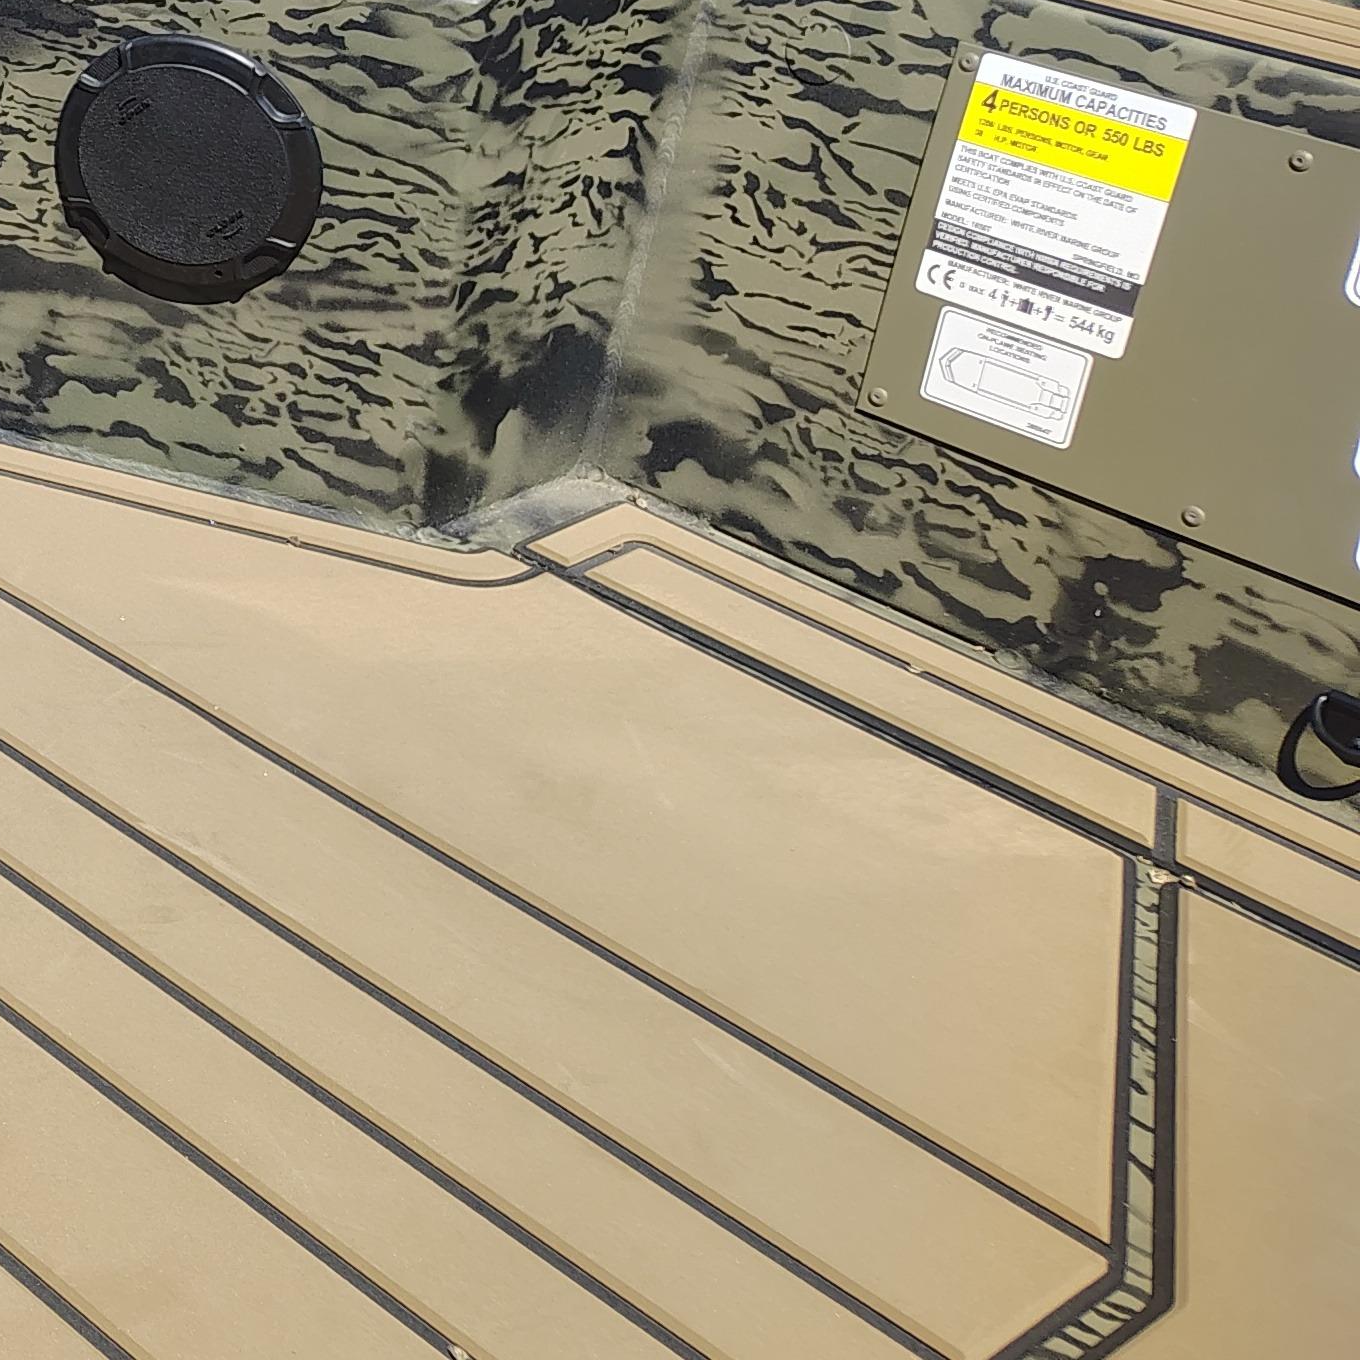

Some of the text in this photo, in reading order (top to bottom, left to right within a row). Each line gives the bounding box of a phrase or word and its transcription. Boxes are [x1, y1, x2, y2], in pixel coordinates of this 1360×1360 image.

[981, 89, 1165, 157] 4 PERSONS OR 550 LBS
[1000, 73, 1168, 131] MAXIMUM CAPACITIES
[1068, 315, 1095, 334] 544
[1095, 324, 1115, 344] kg
